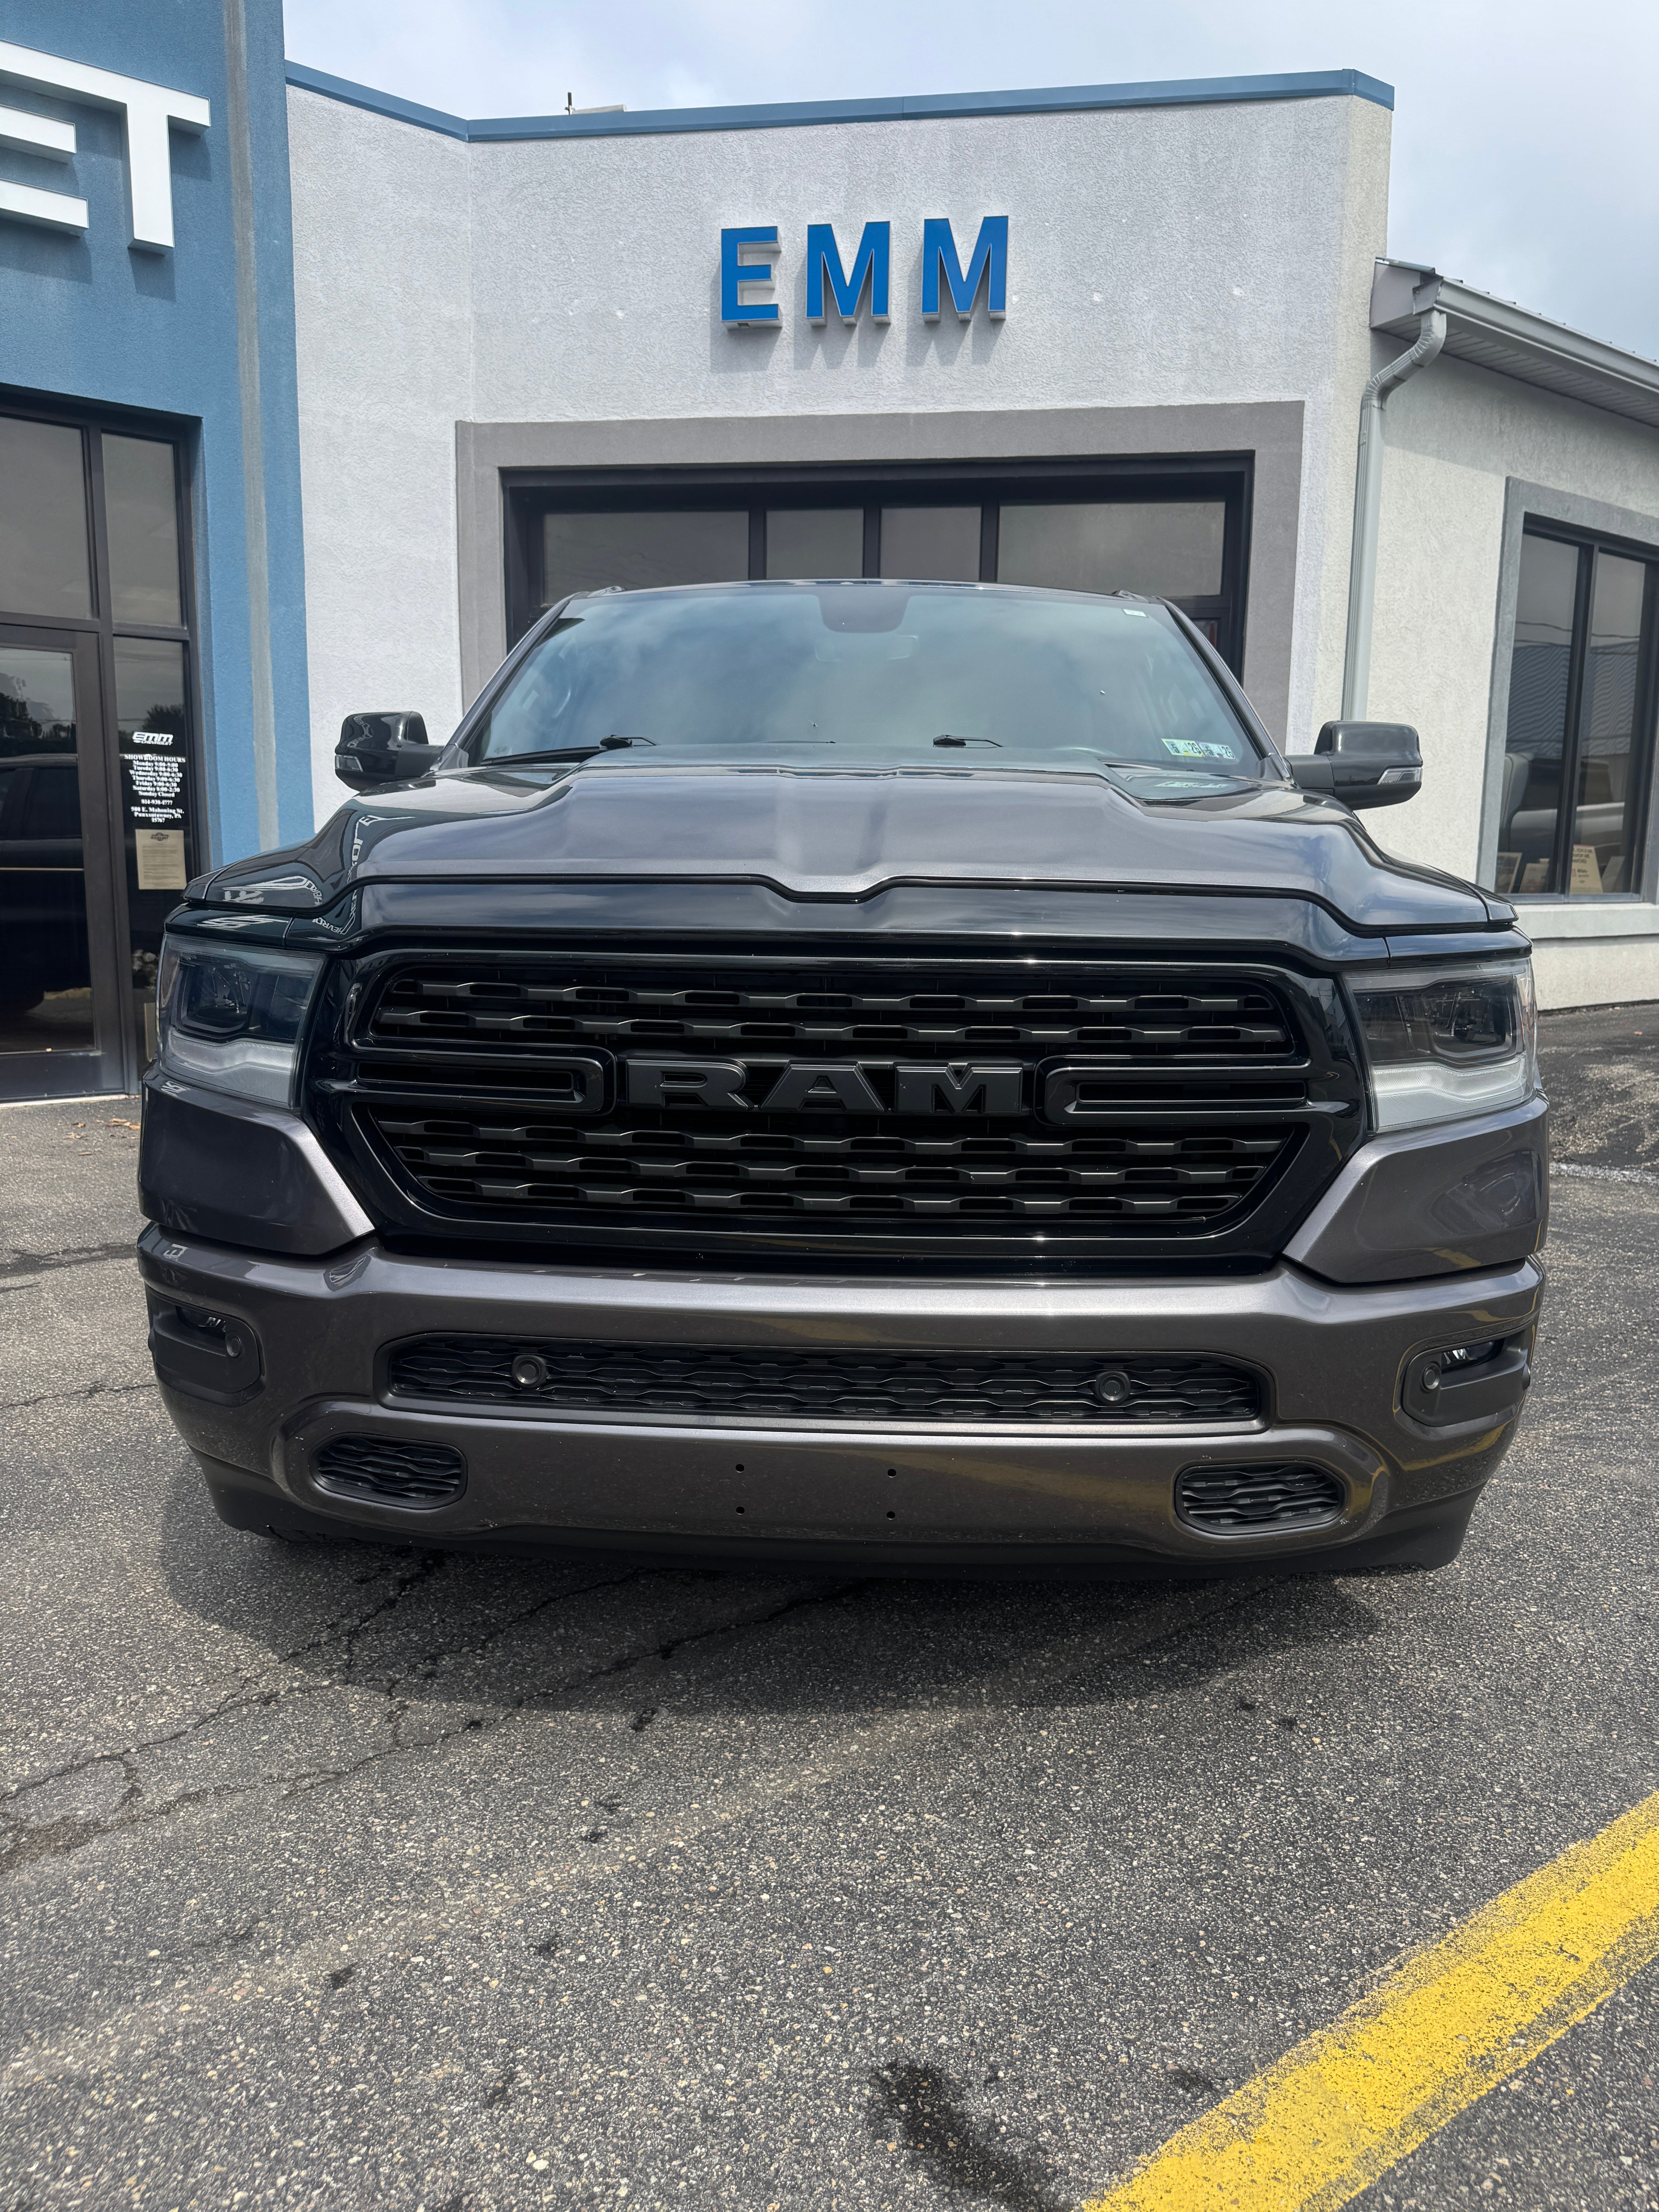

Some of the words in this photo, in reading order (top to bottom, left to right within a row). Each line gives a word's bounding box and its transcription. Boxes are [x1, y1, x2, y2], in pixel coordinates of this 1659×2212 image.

[721, 215, 1009, 328] EMM
[1187, 742, 1201, 754] 26
[1221, 746, 1235, 758] 26
[124, 754, 163, 762] SHOWROOM
[625, 1058, 1024, 1114] RAM
